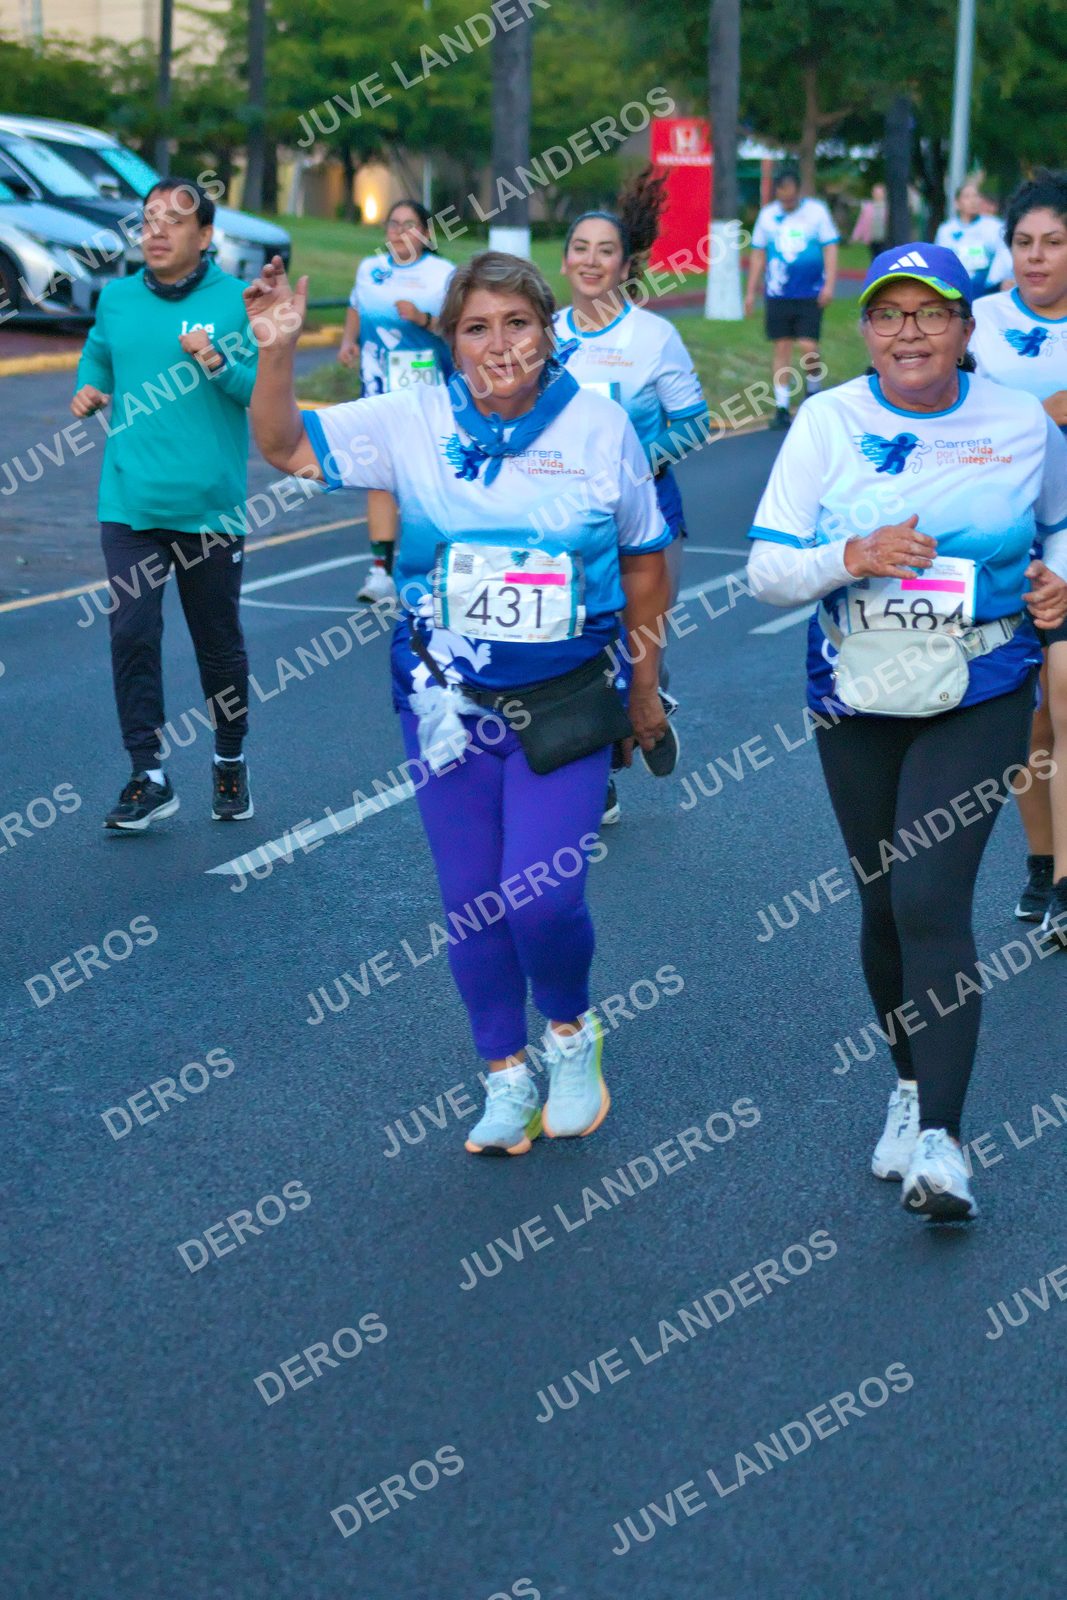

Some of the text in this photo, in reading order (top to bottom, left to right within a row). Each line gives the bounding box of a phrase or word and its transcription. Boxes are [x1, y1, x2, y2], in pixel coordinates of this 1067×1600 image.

[934, 437, 992, 449] Carrera
[516, 449, 562, 459] arrera
[958, 454, 1013, 465] Integridad
[539, 459, 564, 469] Vida
[465, 585, 542, 629] 431
[855, 598, 964, 630] 1584
